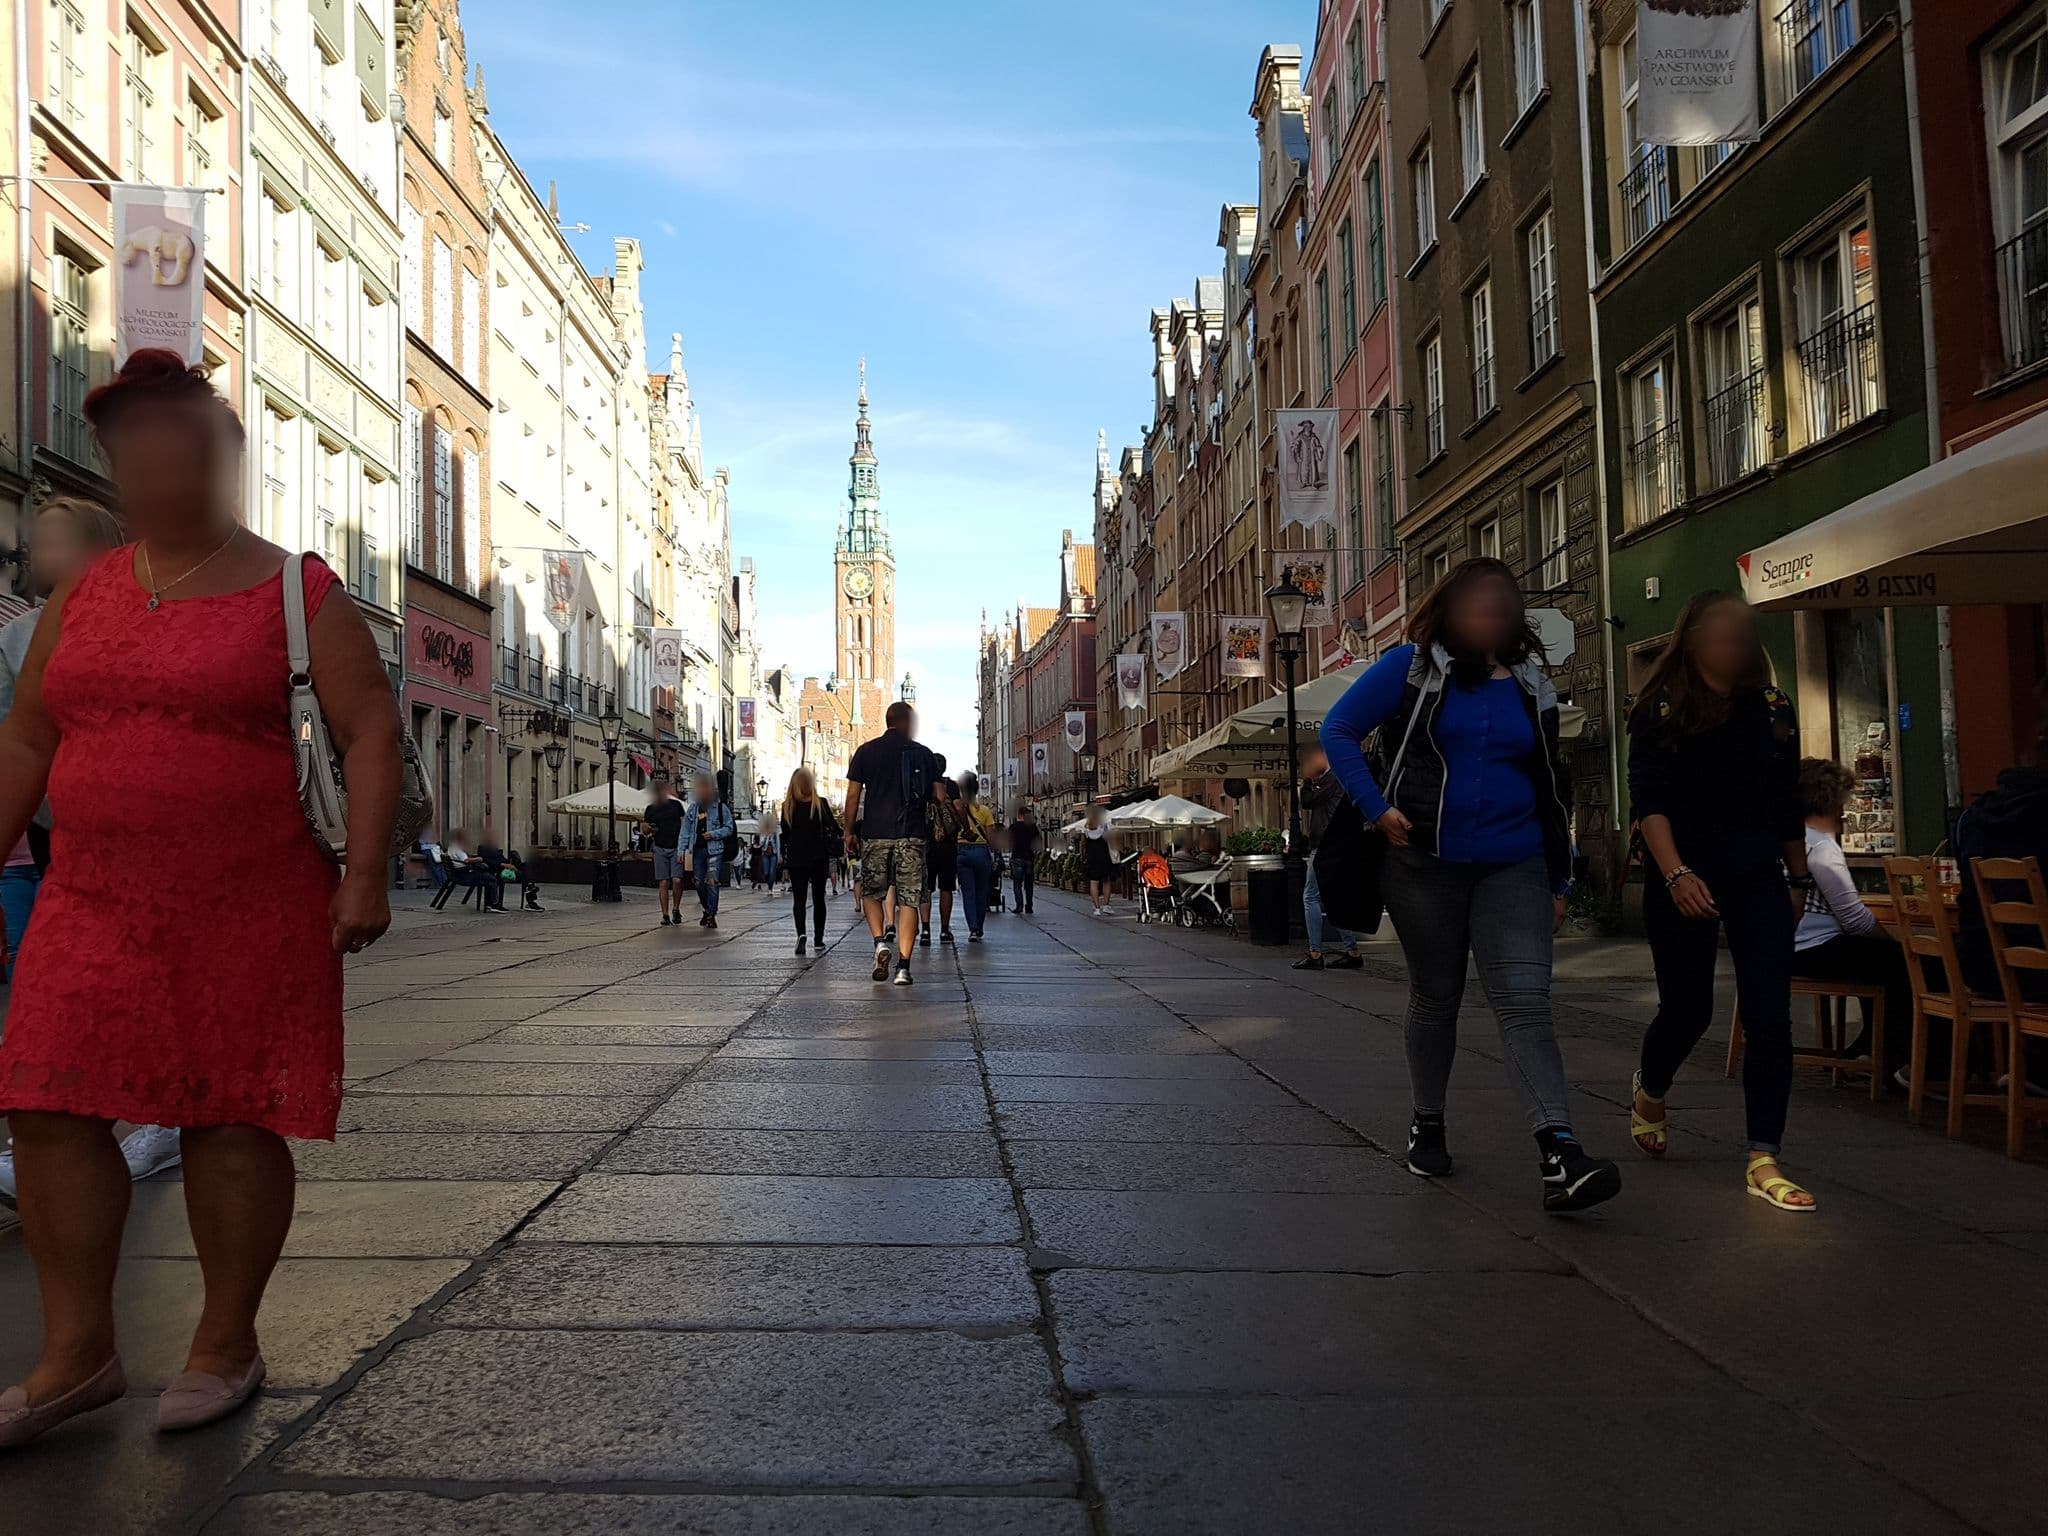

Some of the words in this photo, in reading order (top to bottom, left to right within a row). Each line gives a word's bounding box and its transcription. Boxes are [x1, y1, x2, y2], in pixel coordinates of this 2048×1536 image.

[1655, 48, 1729, 59] ARCHIWUM
[1650, 60, 1737, 73] PAŃSTWOWE
[1653, 76, 1667, 87] W
[1670, 74, 1734, 87] GDAŃSKU
[135, 308, 179, 319] MUZEUM
[1760, 552, 1814, 583] Sempre
